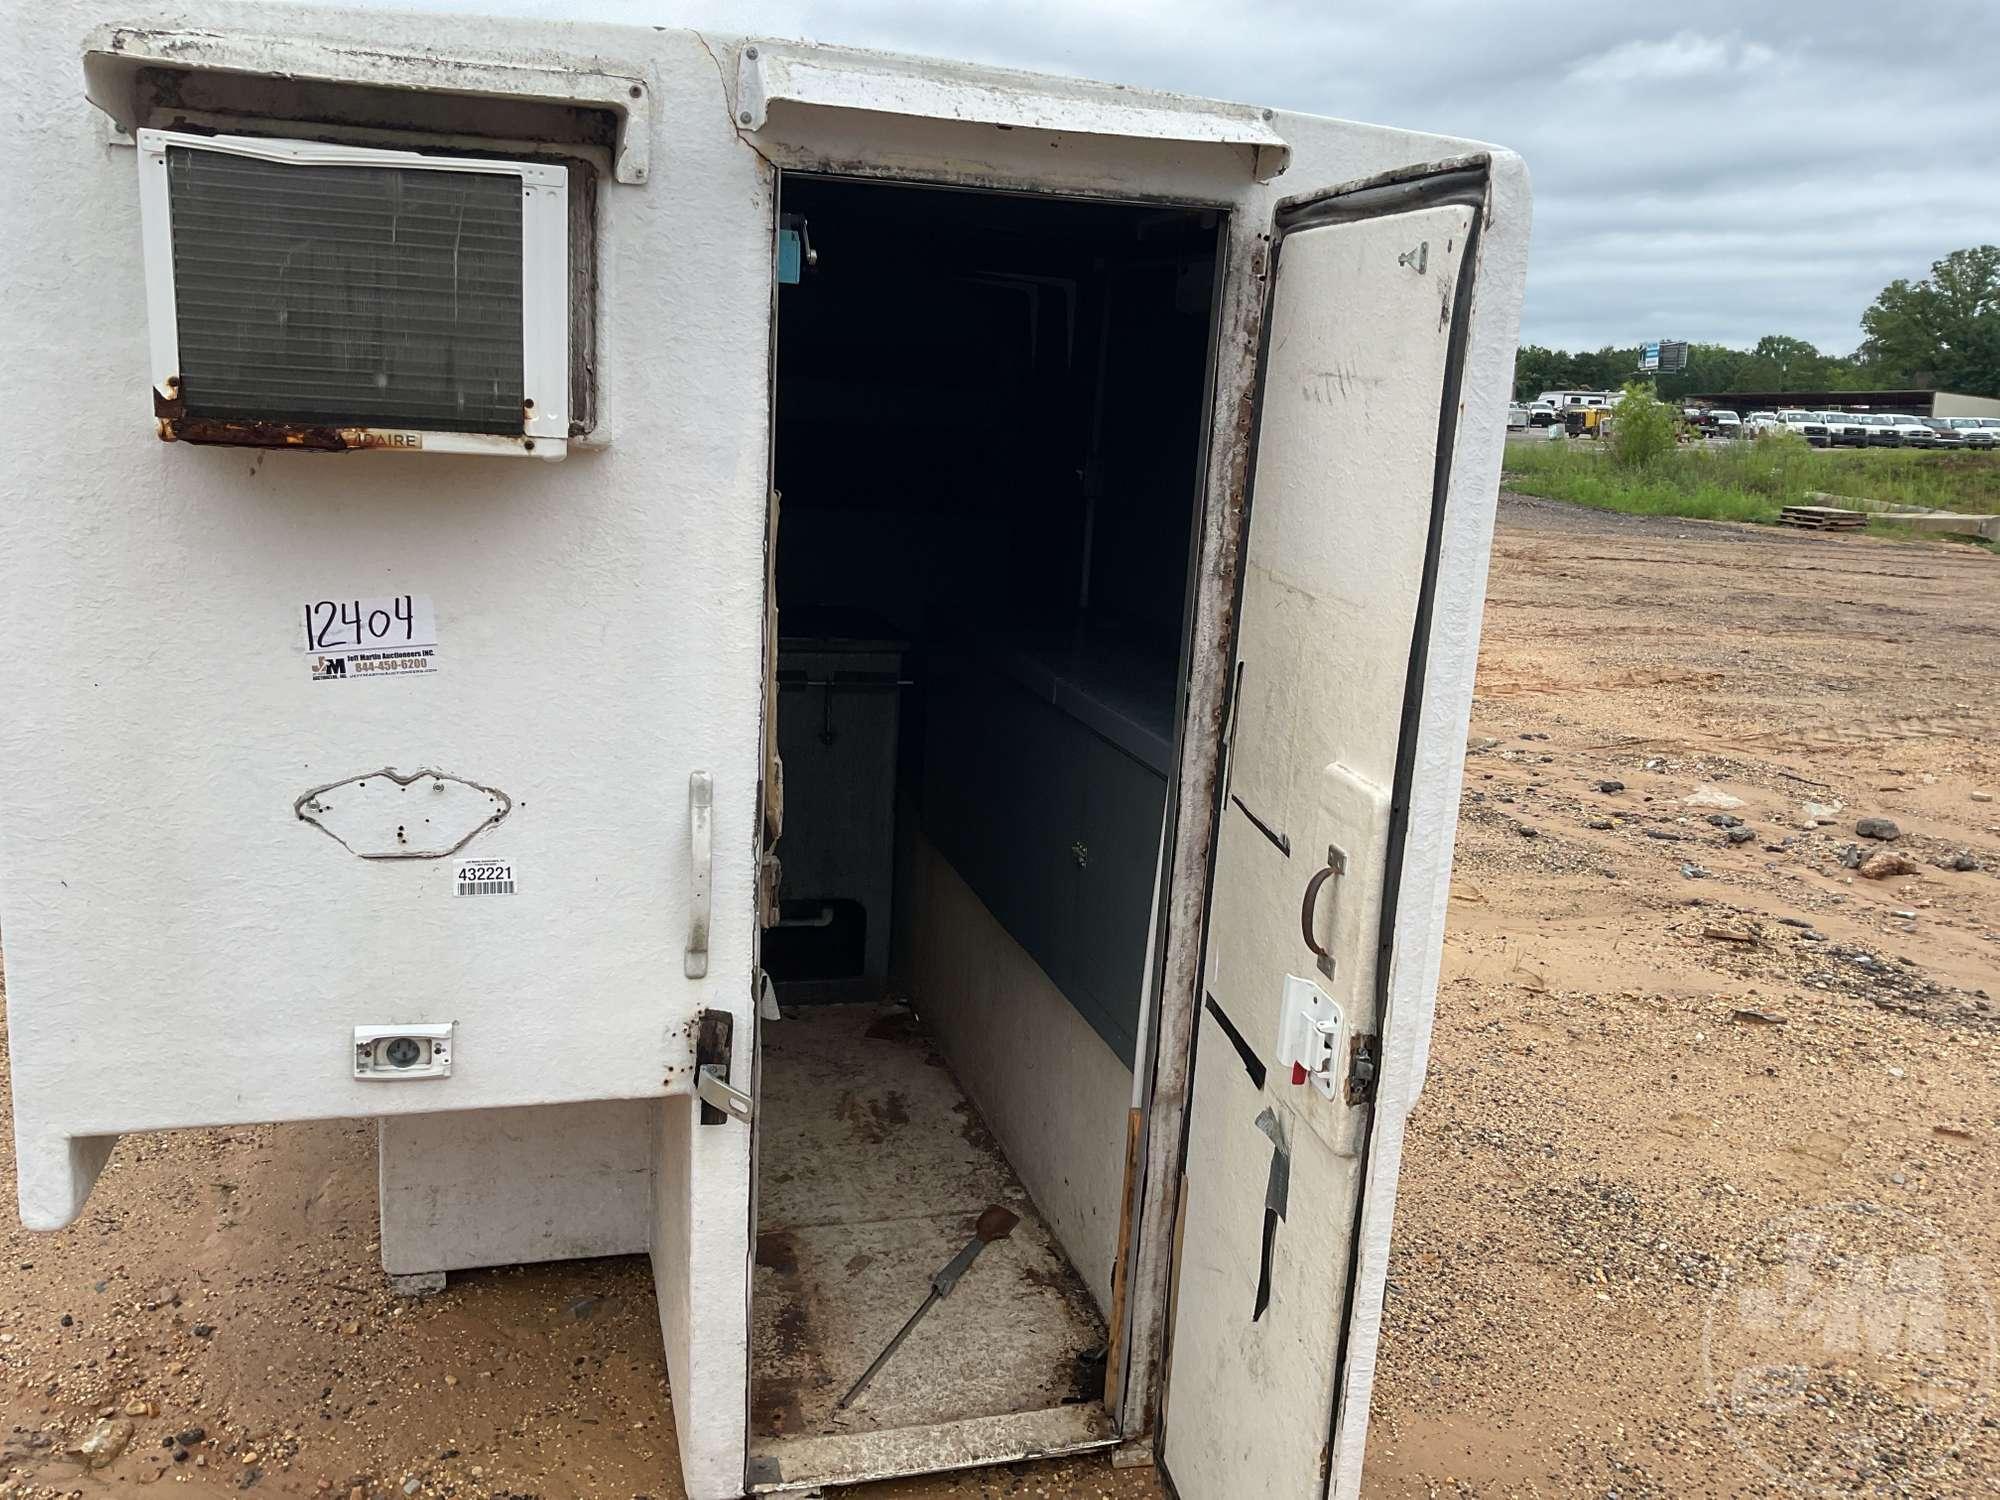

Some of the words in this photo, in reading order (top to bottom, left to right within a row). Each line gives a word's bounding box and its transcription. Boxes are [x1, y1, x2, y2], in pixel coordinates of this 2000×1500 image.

[305, 595, 413, 651] 12404
[360, 653, 381, 661] Martin
[382, 651, 421, 660] Auctioneers
[355, 657, 428, 673] 844-450-6200
[458, 866, 511, 881] 432221
